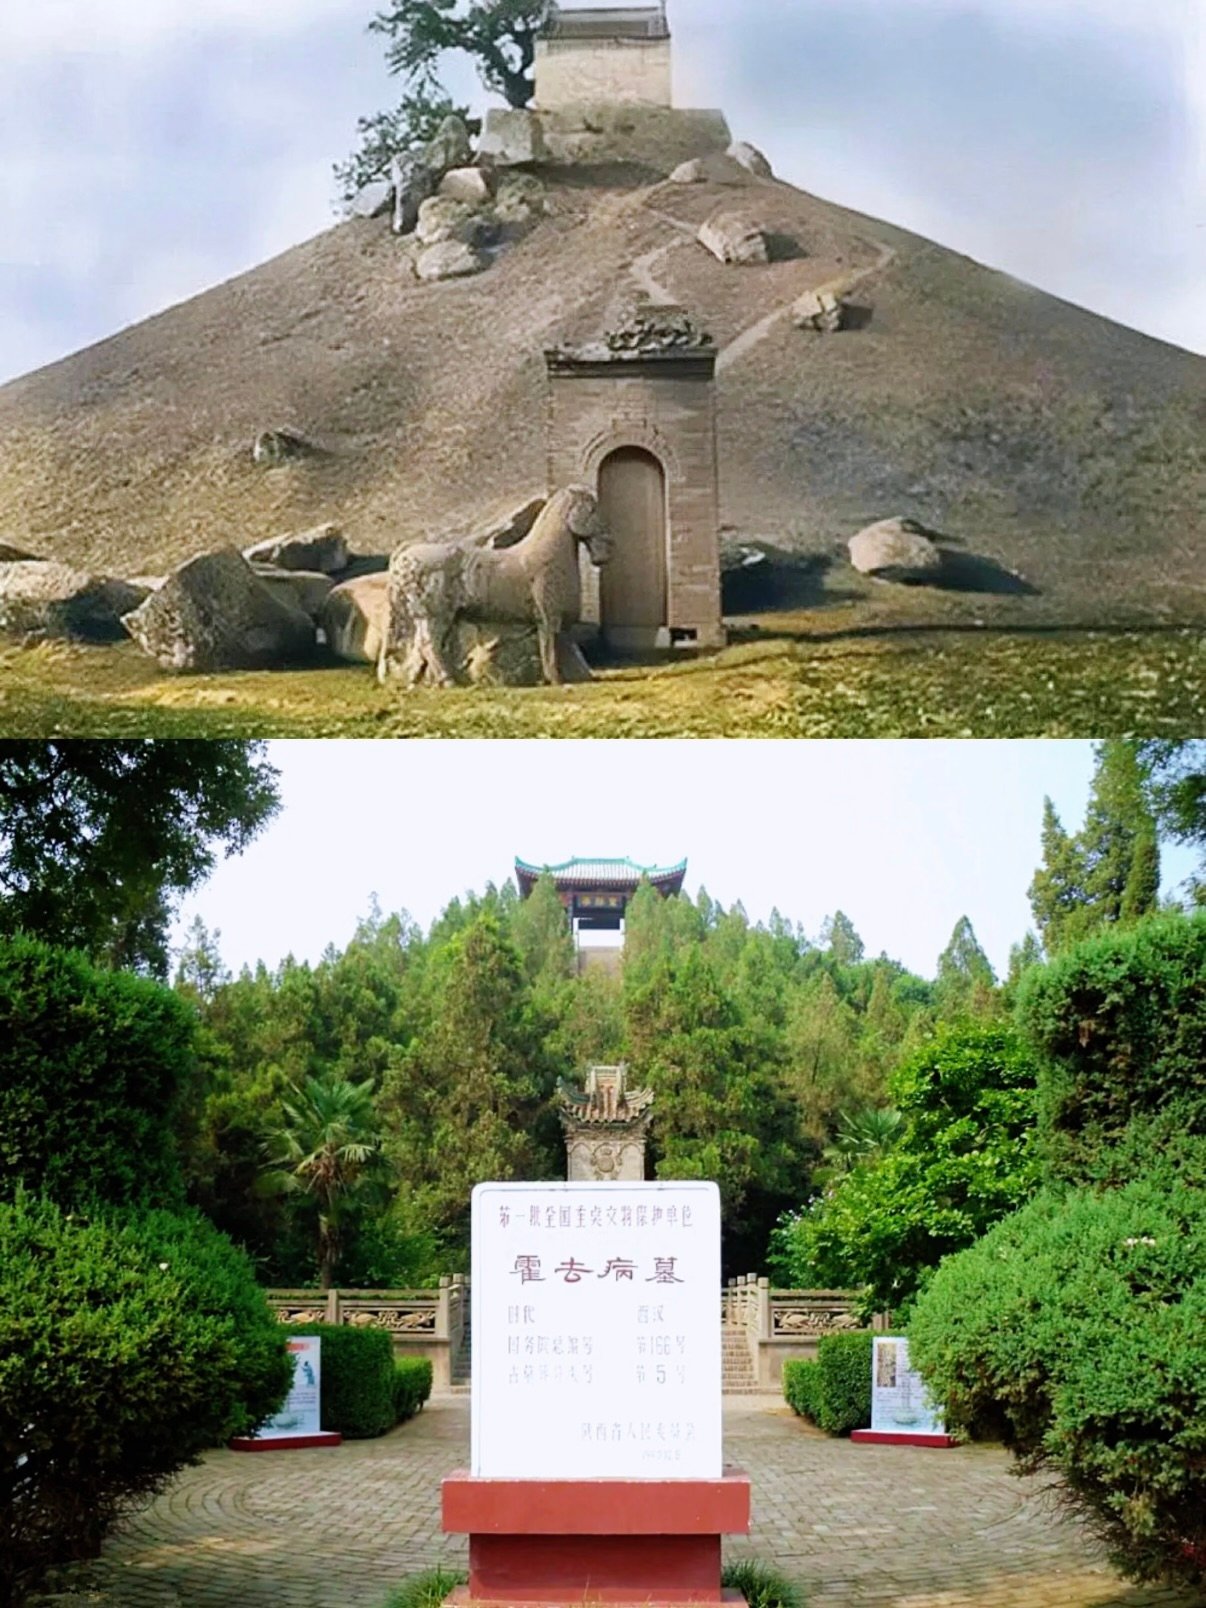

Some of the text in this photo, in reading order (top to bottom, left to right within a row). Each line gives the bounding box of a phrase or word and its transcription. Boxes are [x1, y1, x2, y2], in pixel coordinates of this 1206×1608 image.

[509, 1254, 685, 1285] 霍去病墓
[637, 1304, 665, 1324] 西汉
